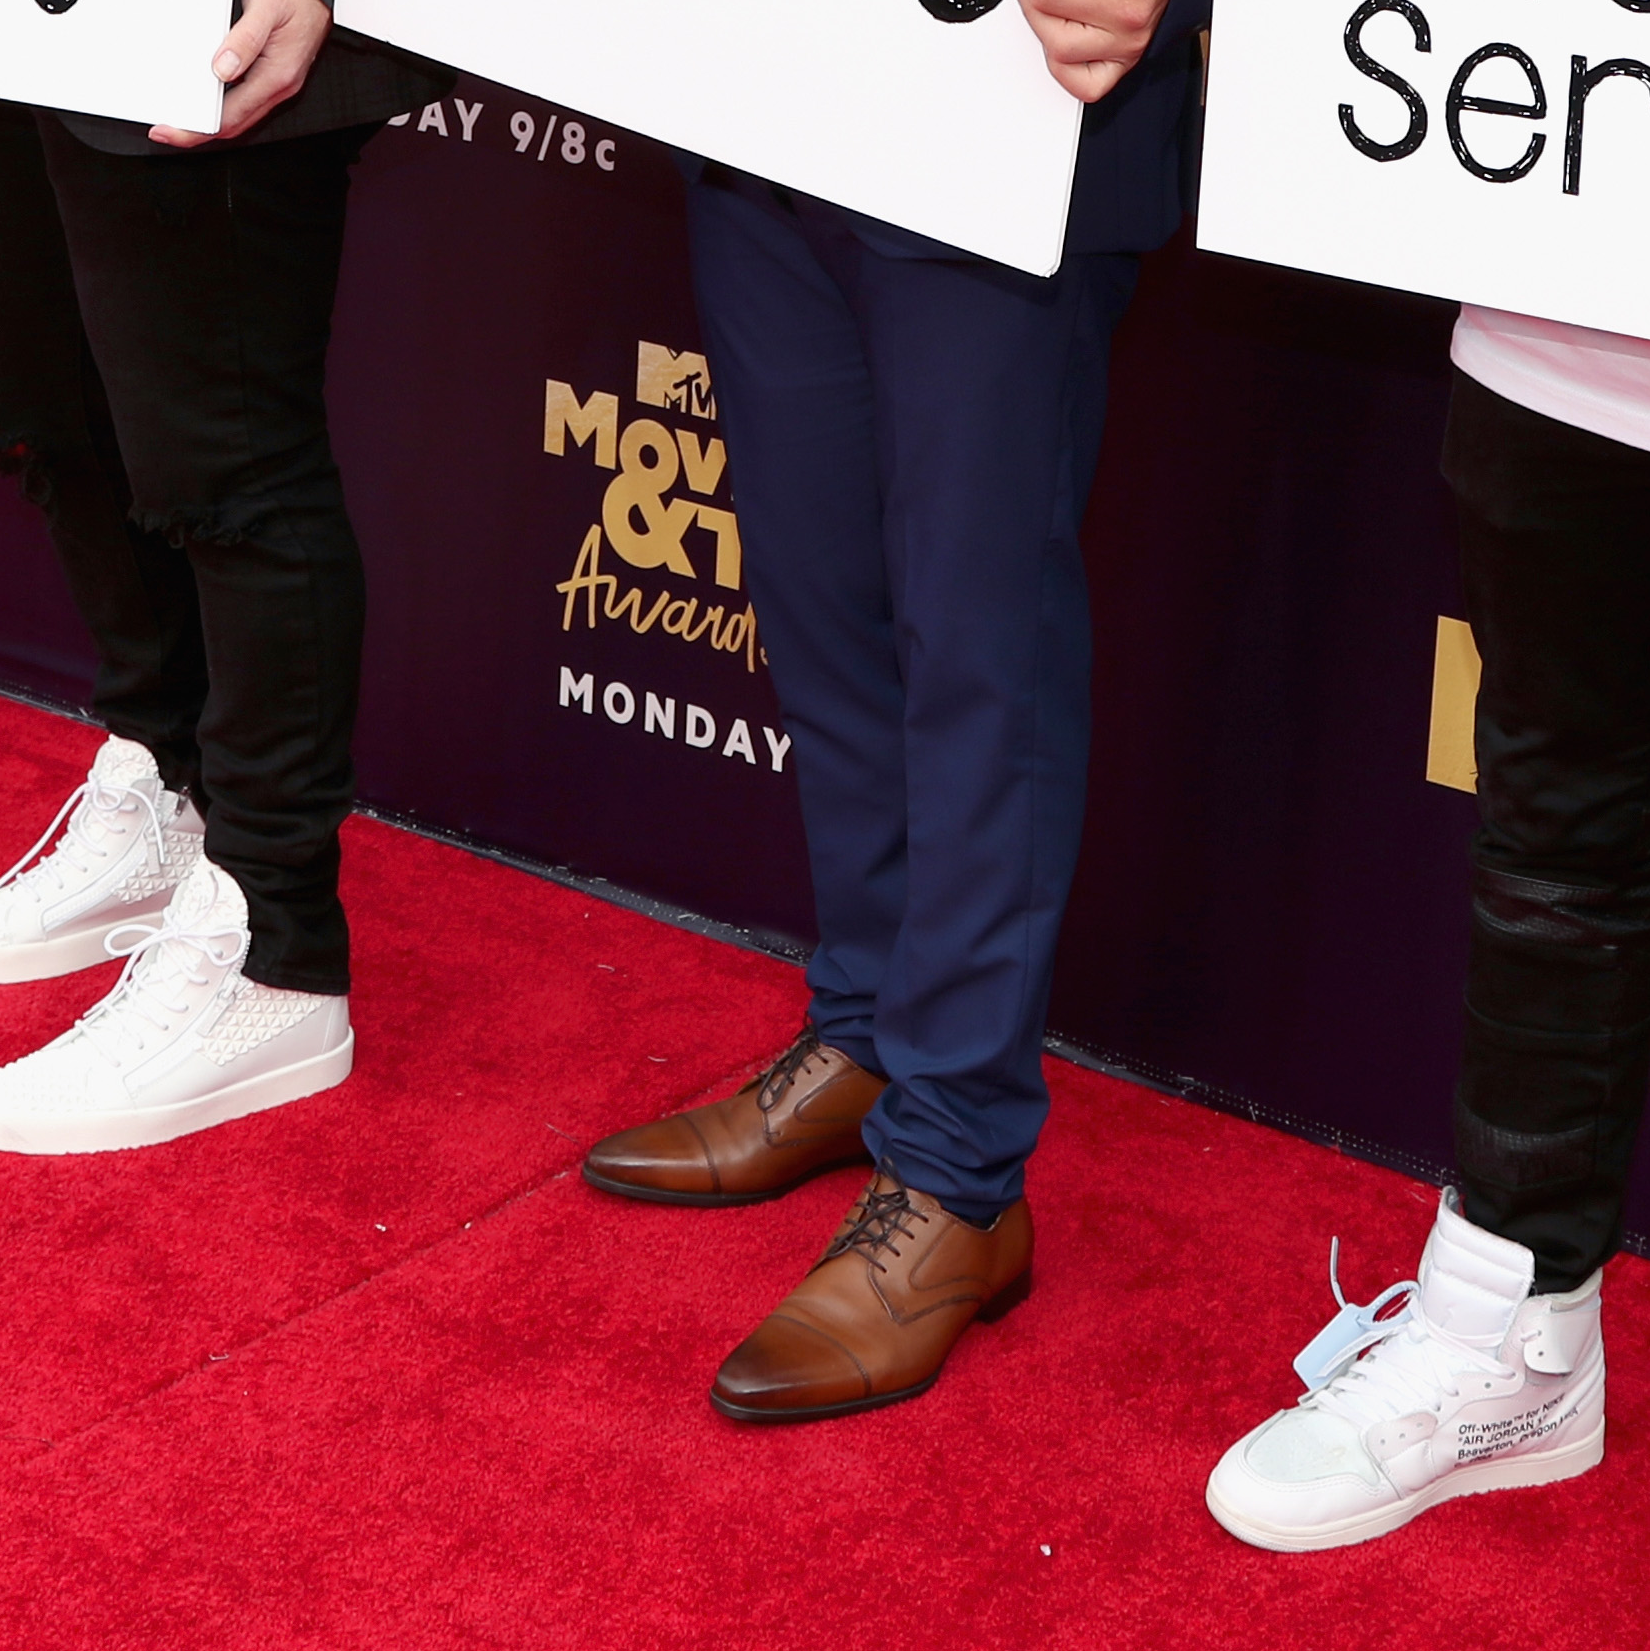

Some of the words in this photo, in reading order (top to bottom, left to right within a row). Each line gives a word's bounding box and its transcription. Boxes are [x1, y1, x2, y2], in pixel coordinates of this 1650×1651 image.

[510, 110, 616, 171] 9/8c
[544, 377, 729, 493] Mov
[602, 474, 741, 590] &T
[555, 524, 768, 673] Award
[558, 666, 792, 773] MONDAY
[1487, 1420, 1534, 1443] JORDAN
